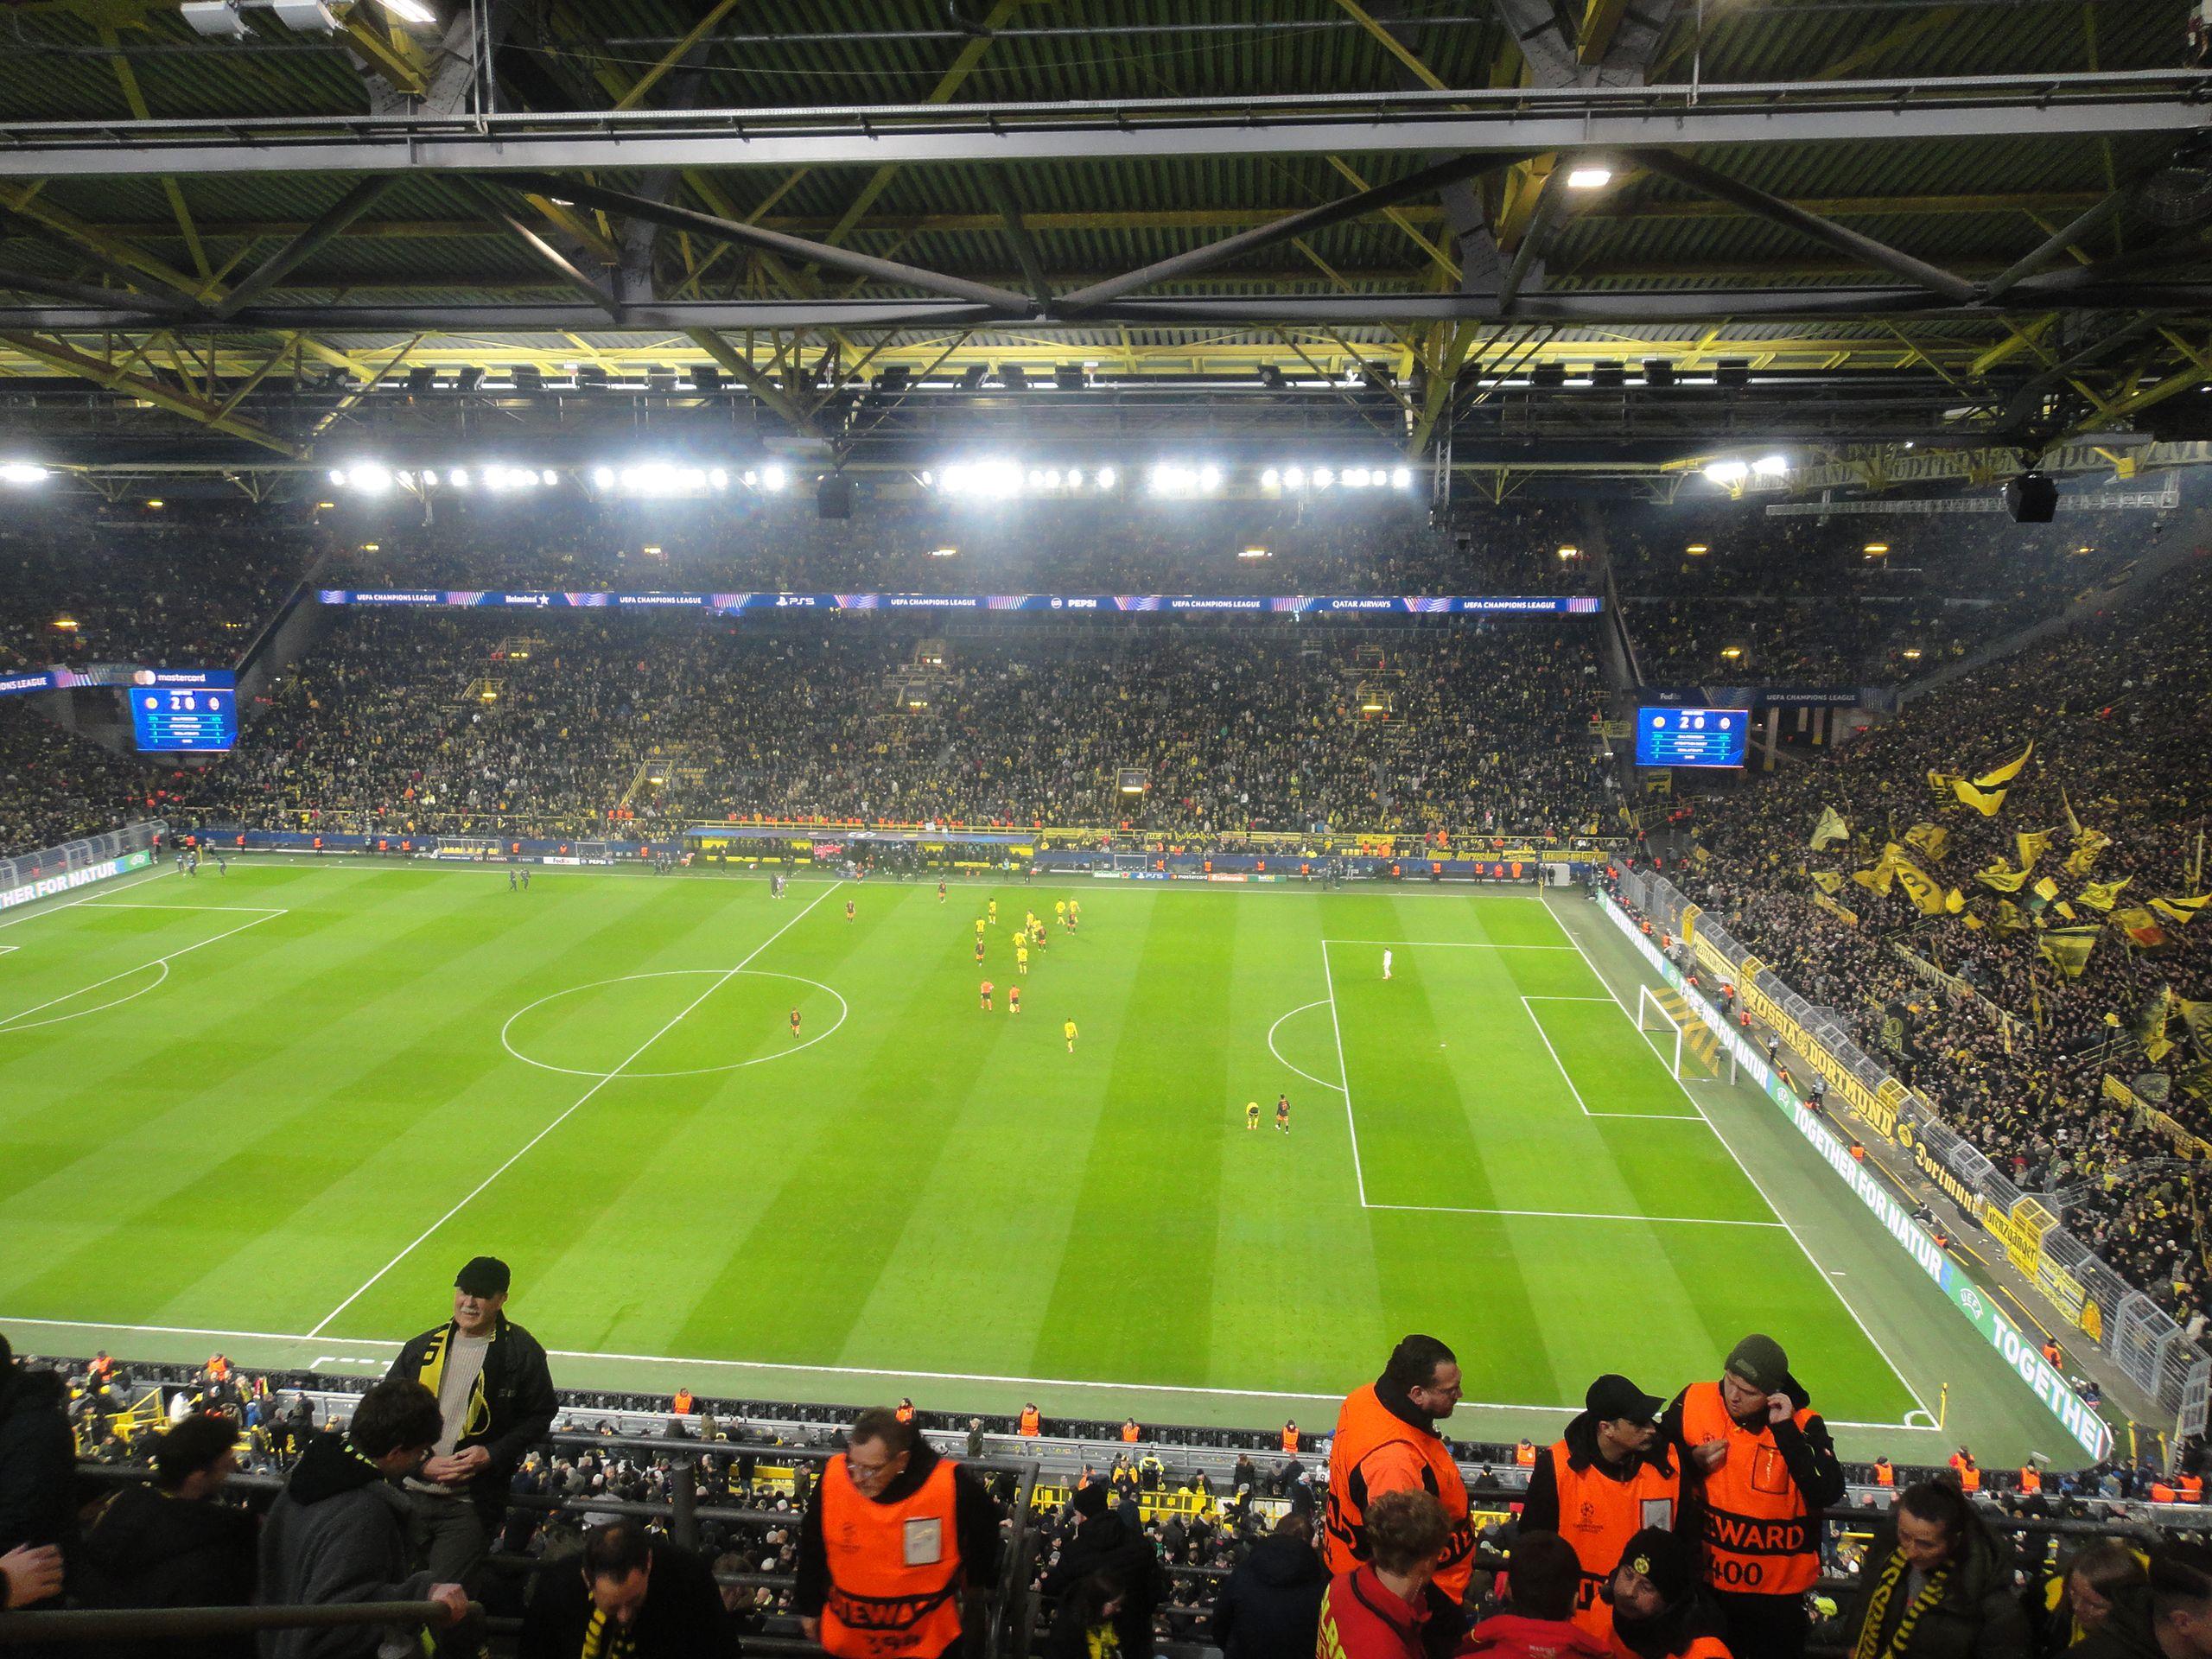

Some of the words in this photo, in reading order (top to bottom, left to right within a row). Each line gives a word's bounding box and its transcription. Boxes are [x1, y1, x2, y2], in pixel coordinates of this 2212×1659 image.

[790, 597, 815, 606] PS5
[1068, 599, 1096, 607] PEPSI
[17, 677, 48, 688] LEAGUE
[157, 673, 207, 682] mastercard
[170, 696, 181, 710] 2
[184, 696, 195, 710] 0
[1679, 716, 1689, 728] 2
[1694, 716, 1705, 729] 0
[35, 874, 68, 898] FOR
[1809, 1039, 1894, 1138] DORTMUND
[1794, 1099, 1857, 1190] TOGETHER
[1856, 1173, 1886, 1222] FOR
[1915, 1141, 1979, 1214] Dortmun
